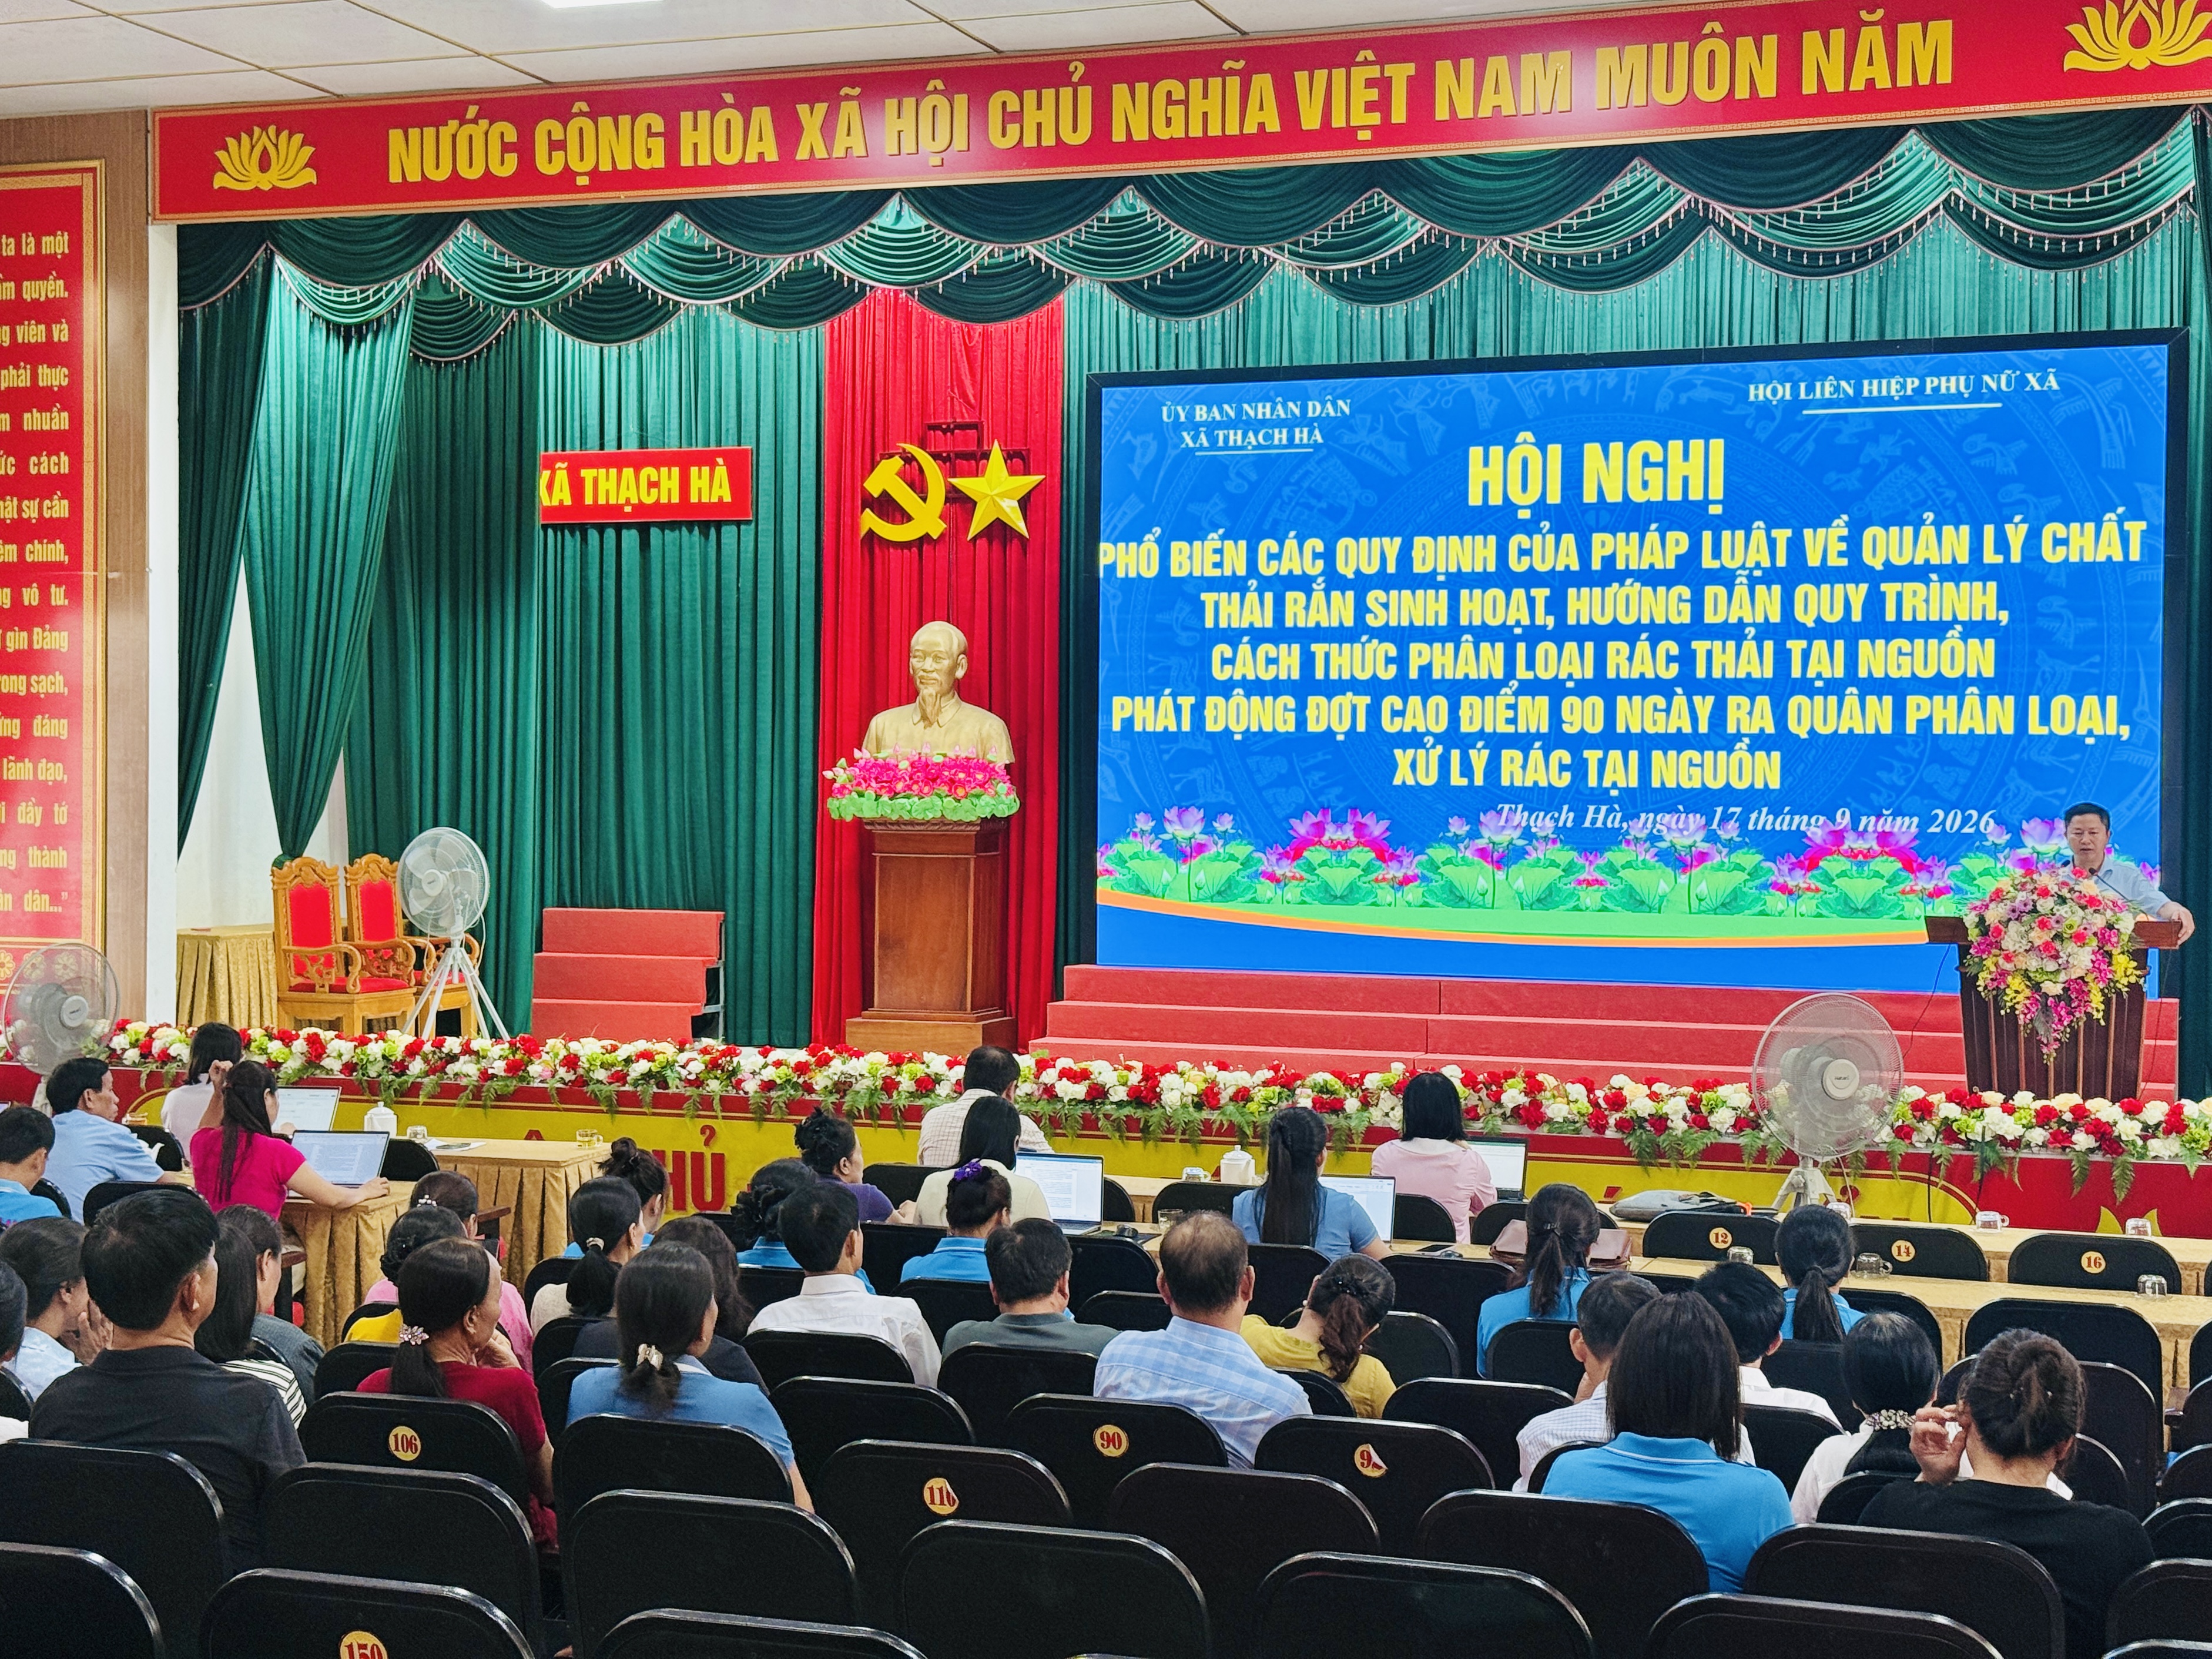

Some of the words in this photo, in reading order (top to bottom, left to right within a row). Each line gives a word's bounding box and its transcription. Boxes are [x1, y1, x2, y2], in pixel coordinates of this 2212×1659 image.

[389, 106, 517, 183] NƯỚC
[535, 102, 665, 185] CỘNG
[681, 93, 779, 166] HÒA
[796, 87, 866, 160] XÃ
[884, 80, 968, 166] HỘI
[988, 62, 1091, 149] CHỦ
[1112, 60, 1281, 142] NGHĨA
[1295, 50, 1415, 140] VIỆT
[1435, 51, 1572, 120] NAM
[1596, 22, 1777, 109] MUÔN
[1802, 9, 1952, 94] NĂM
[1, 235, 15, 256] ta
[22, 232, 35, 256] là
[42, 231, 69, 259] một
[22, 270, 68, 301] quyền.
[16, 320, 46, 343] viên
[52, 319, 69, 343] và
[1, 361, 31, 391] phải
[38, 363, 69, 391] thực
[1750, 381, 1791, 404] HỘI
[1800, 376, 1854, 398] LIÊN
[1863, 376, 1919, 400] HIỆP
[1925, 376, 1973, 397] PHỤ
[1982, 370, 2019, 391] NỮ
[2026, 368, 2059, 390] XÃ
[24, 403, 69, 431] nhuần
[1162, 402, 1189, 421] ỦY
[1195, 404, 1235, 421] BAN
[1242, 397, 1300, 419] NHÂN
[1308, 396, 1350, 417] DÂN
[1181, 428, 1208, 447] XÃ
[1215, 428, 1287, 449] THẠCH
[1295, 423, 1323, 444] HÀ
[29, 451, 69, 475] cách
[1469, 432, 1561, 518] HỘI
[1584, 439, 1724, 514] NGHỊ
[581, 467, 679, 512] THẠCH
[691, 458, 731, 502] HÀ
[22, 498, 39, 524] sự
[43, 490, 69, 519] cần
[25, 539, 69, 564] chính,
[1100, 528, 1161, 578] PHỔ
[1171, 529, 1246, 577] BIẾN
[1258, 531, 1323, 575] CÁC
[1336, 538, 1401, 578] QUY
[1412, 535, 1496, 581] ĐỊNH
[1509, 522, 1579, 572] CỦA
[1592, 524, 1688, 569] PHÁP
[1702, 521, 1791, 577] LUẬT
[1804, 515, 1848, 566] VỀ
[1863, 512, 1969, 567] QUẢN
[1984, 515, 2028, 563] LÝ
[2042, 508, 2146, 562] CHẤT
[22, 582, 39, 606] vô
[51, 584, 68, 606] tư.
[1201, 580, 1272, 628] THẢI
[1286, 578, 1353, 626] RẮN
[1366, 590, 1447, 626] SINH
[1460, 588, 1554, 635] HOẠT,
[1568, 579, 1690, 625] HƯỚNG
[1704, 569, 1781, 624] DẪN
[1795, 584, 1868, 625] QUY
[1881, 574, 2008, 626] TRÌNH,
[6, 626, 28, 652] gìn
[32, 624, 69, 652] Đảng
[1212, 637, 1299, 680] CÁCH
[1311, 636, 1396, 679] THỨC
[1410, 635, 1503, 679] PHÂN
[1517, 642, 1593, 687] LOẠI
[1607, 634, 1678, 679] RÁC
[1692, 627, 1773, 678] THẢI
[1787, 640, 1844, 686] TẠI
[1859, 625, 1994, 678] NGUỒN
[31, 671, 68, 698] sạch,
[1112, 689, 1195, 731] PHÁT
[1205, 689, 1295, 739] ĐỘNG
[1306, 692, 1370, 740] ĐỢT
[1382, 696, 1447, 732] CAO
[1459, 679, 1549, 732] ĐIỂM
[1562, 696, 1603, 733] 90
[1617, 688, 1714, 733] NGÀY
[1728, 696, 1774, 733] RA
[1788, 687, 1892, 736] QUÂN
[1906, 687, 2014, 734] PHÂN
[2029, 695, 2129, 743] LOẠI,
[33, 714, 68, 740] đáng
[3, 755, 33, 780] lãnh
[38, 758, 68, 785] đạo,
[1393, 736, 1442, 785] XỬ
[1451, 742, 1489, 785] LÝ
[1502, 742, 1571, 787] RÁC
[1584, 750, 1638, 795] TẠI
[1652, 738, 1780, 789] NGUỒN
[18, 797, 43, 827] đầy
[54, 801, 68, 825] tớ
[1497, 803, 1574, 833] Thạch
[1581, 805, 1628, 833] Hà,
[1639, 805, 1706, 835] ngày
[1708, 806, 1742, 830] 17
[1748, 806, 1825, 836] tháng
[1835, 807, 1851, 830] 9
[1858, 807, 1919, 832] năm
[1927, 809, 1997, 833] 2026
[28, 846, 68, 869] thành
[1713, 1231, 1728, 1244] 12
[1896, 1245, 1912, 1257] 14
[2086, 1255, 2102, 1269] 16
[392, 1433, 418, 1454] 106
[1100, 1430, 1122, 1450] 90
